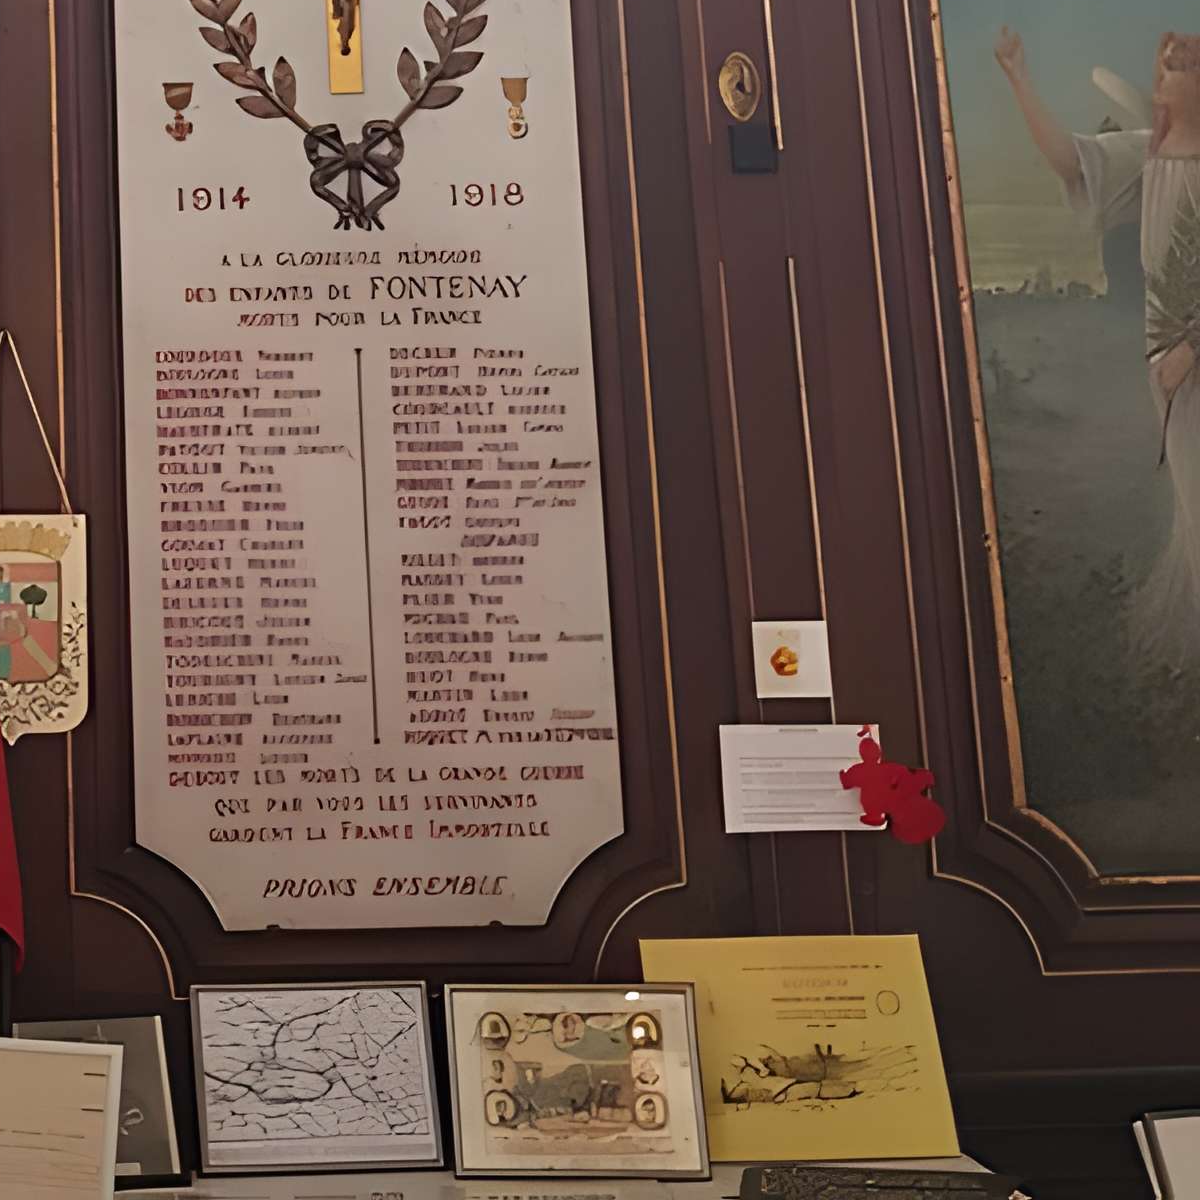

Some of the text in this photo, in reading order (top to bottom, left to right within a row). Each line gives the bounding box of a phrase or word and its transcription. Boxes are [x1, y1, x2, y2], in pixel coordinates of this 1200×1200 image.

[178, 186, 250, 211] 1914
[450, 182, 524, 207] 1918
[370, 275, 527, 300] FONTENAY
[381, 311, 401, 326] LA
[263, 875, 507, 898] PRIONS ENSEMBLE
